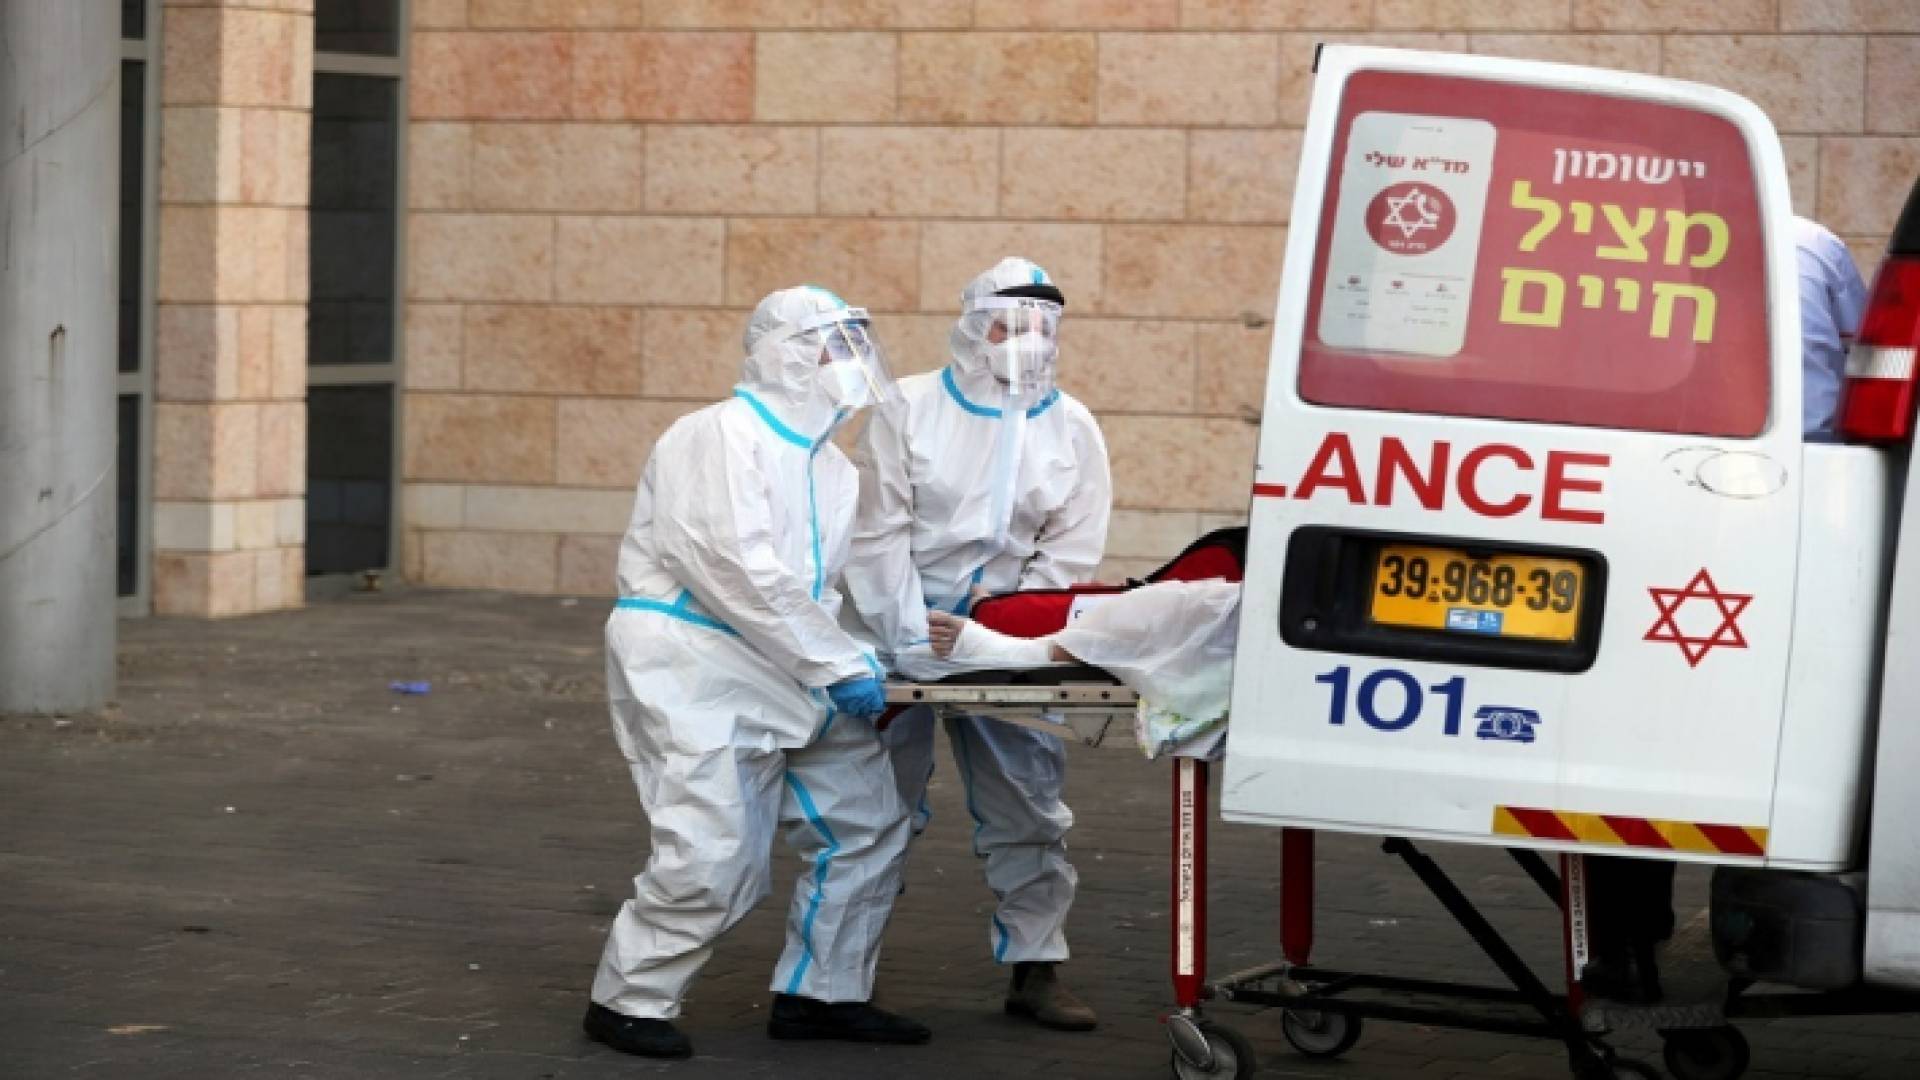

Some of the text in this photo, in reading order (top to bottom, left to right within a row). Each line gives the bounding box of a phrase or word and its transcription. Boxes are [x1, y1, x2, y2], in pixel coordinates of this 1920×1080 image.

[1364, 150, 1406, 169] שלי
[1552, 147, 1706, 185] יישומון
[1510, 180, 1730, 269] מציל
[1499, 267, 1718, 343] חיים
[1315, 666, 1466, 736] 101
